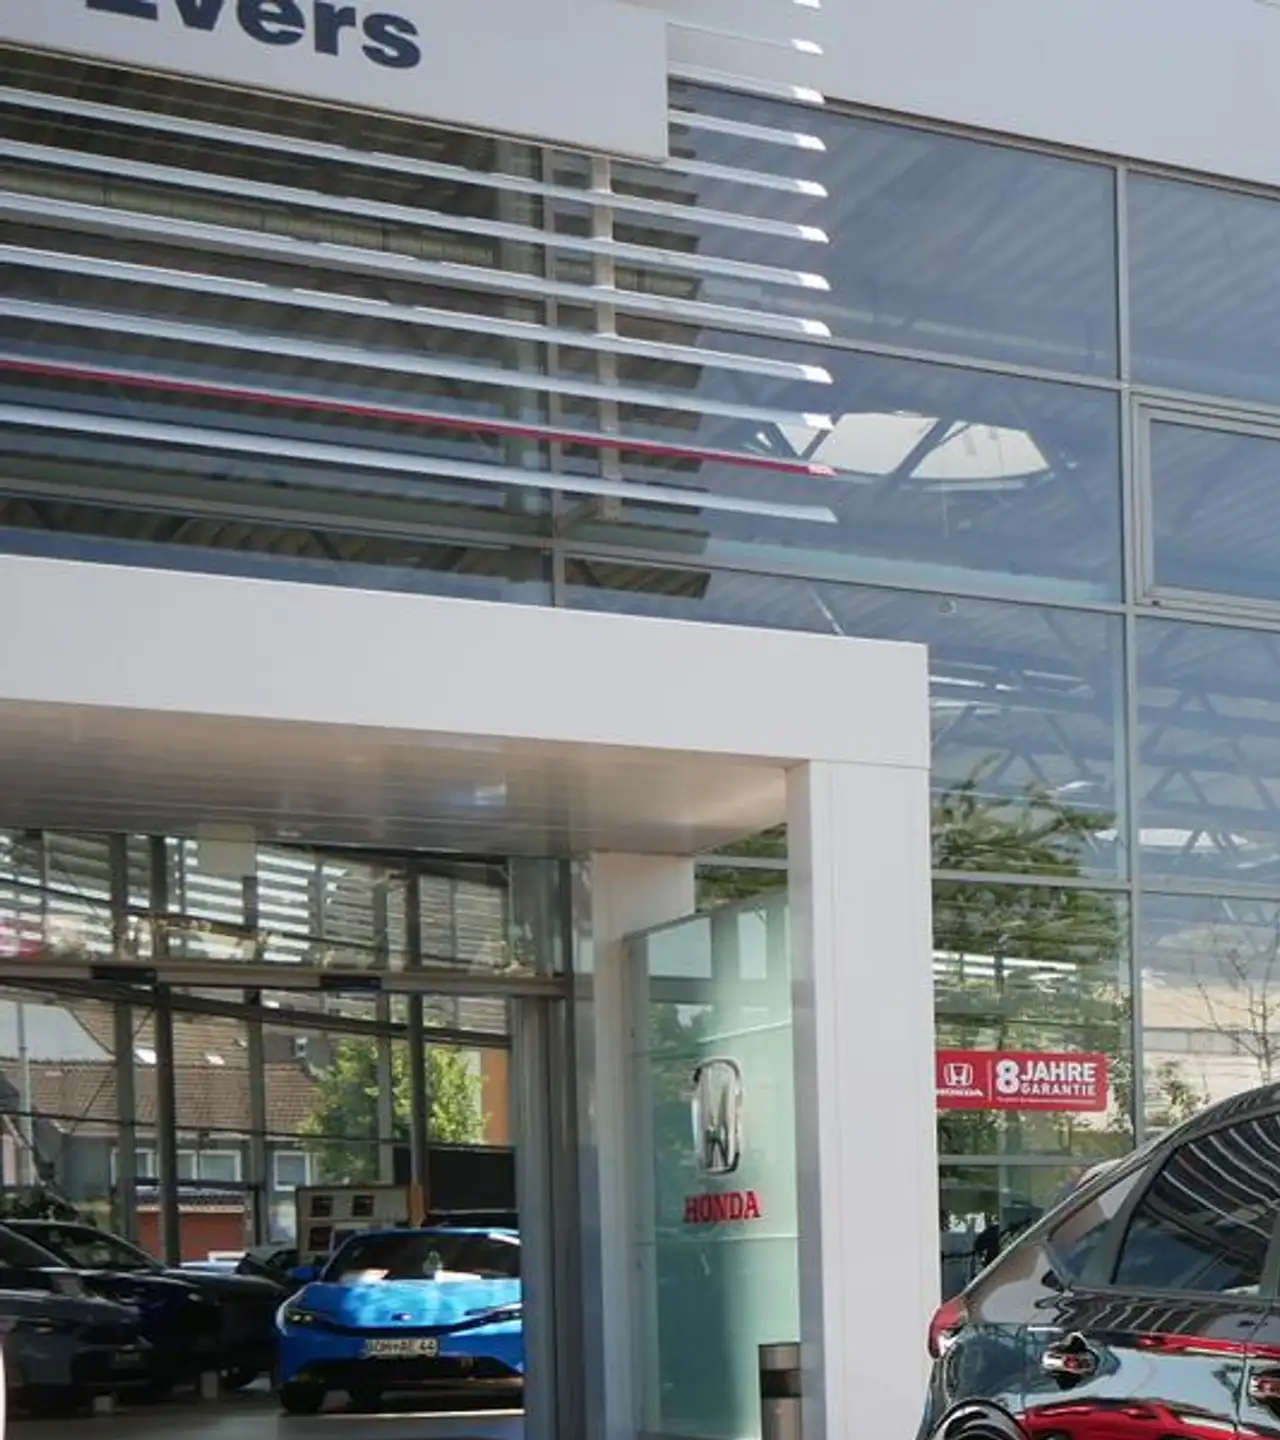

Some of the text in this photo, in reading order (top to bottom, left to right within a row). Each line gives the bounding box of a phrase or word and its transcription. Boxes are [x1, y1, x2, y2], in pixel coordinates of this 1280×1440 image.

[85, 0, 422, 69] vers
[995, 1059, 1097, 1094] 8 JAHRE
[1021, 1082, 1096, 1097] GARANTIE
[682, 1190, 761, 1224] HONDA
